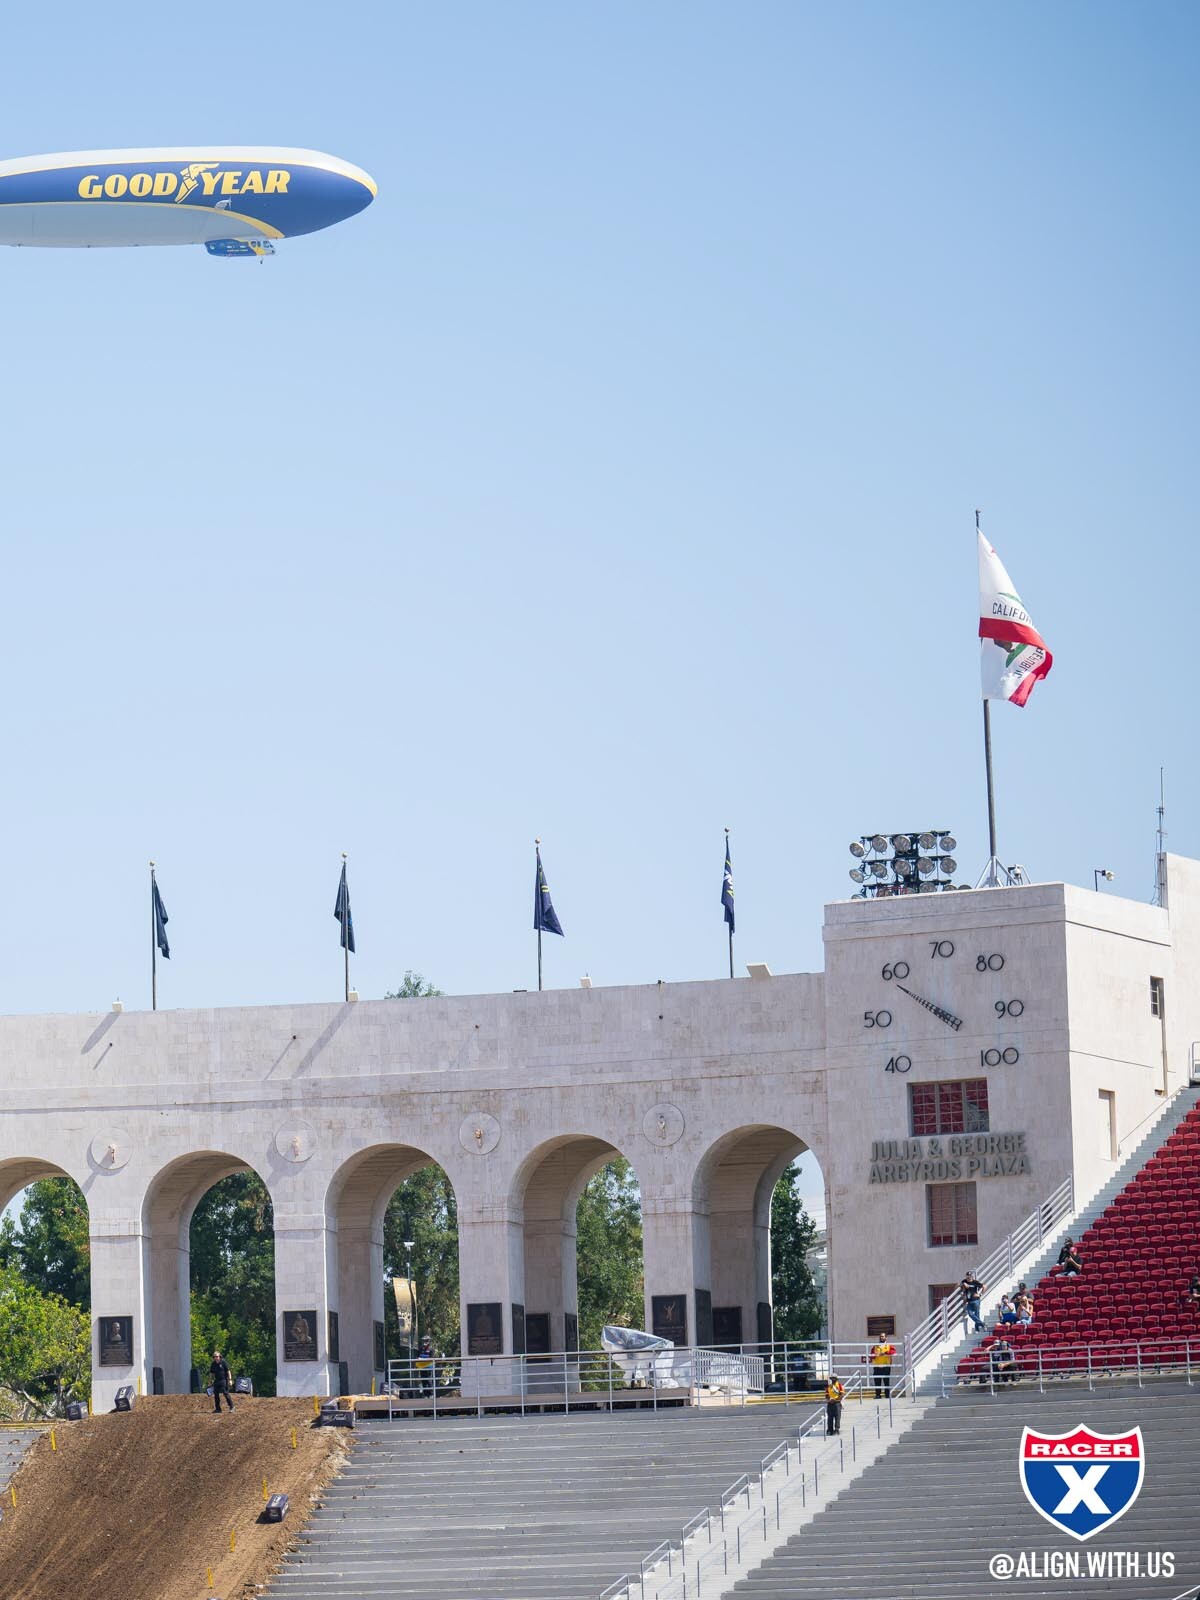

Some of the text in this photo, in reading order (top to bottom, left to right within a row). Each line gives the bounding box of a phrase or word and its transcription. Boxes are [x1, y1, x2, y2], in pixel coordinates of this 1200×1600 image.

[929, 940, 955, 958] 70
[881, 961, 910, 981] 60
[976, 953, 1005, 972] 80
[994, 999, 1025, 1019] 90
[863, 1010, 893, 1029] 50
[884, 1055, 912, 1074] 40
[980, 1047, 1020, 1067] 100
[870, 1131, 1027, 1162] JULIA & GEORGE
[869, 1154, 1031, 1184] ARGYROS PLAZA
